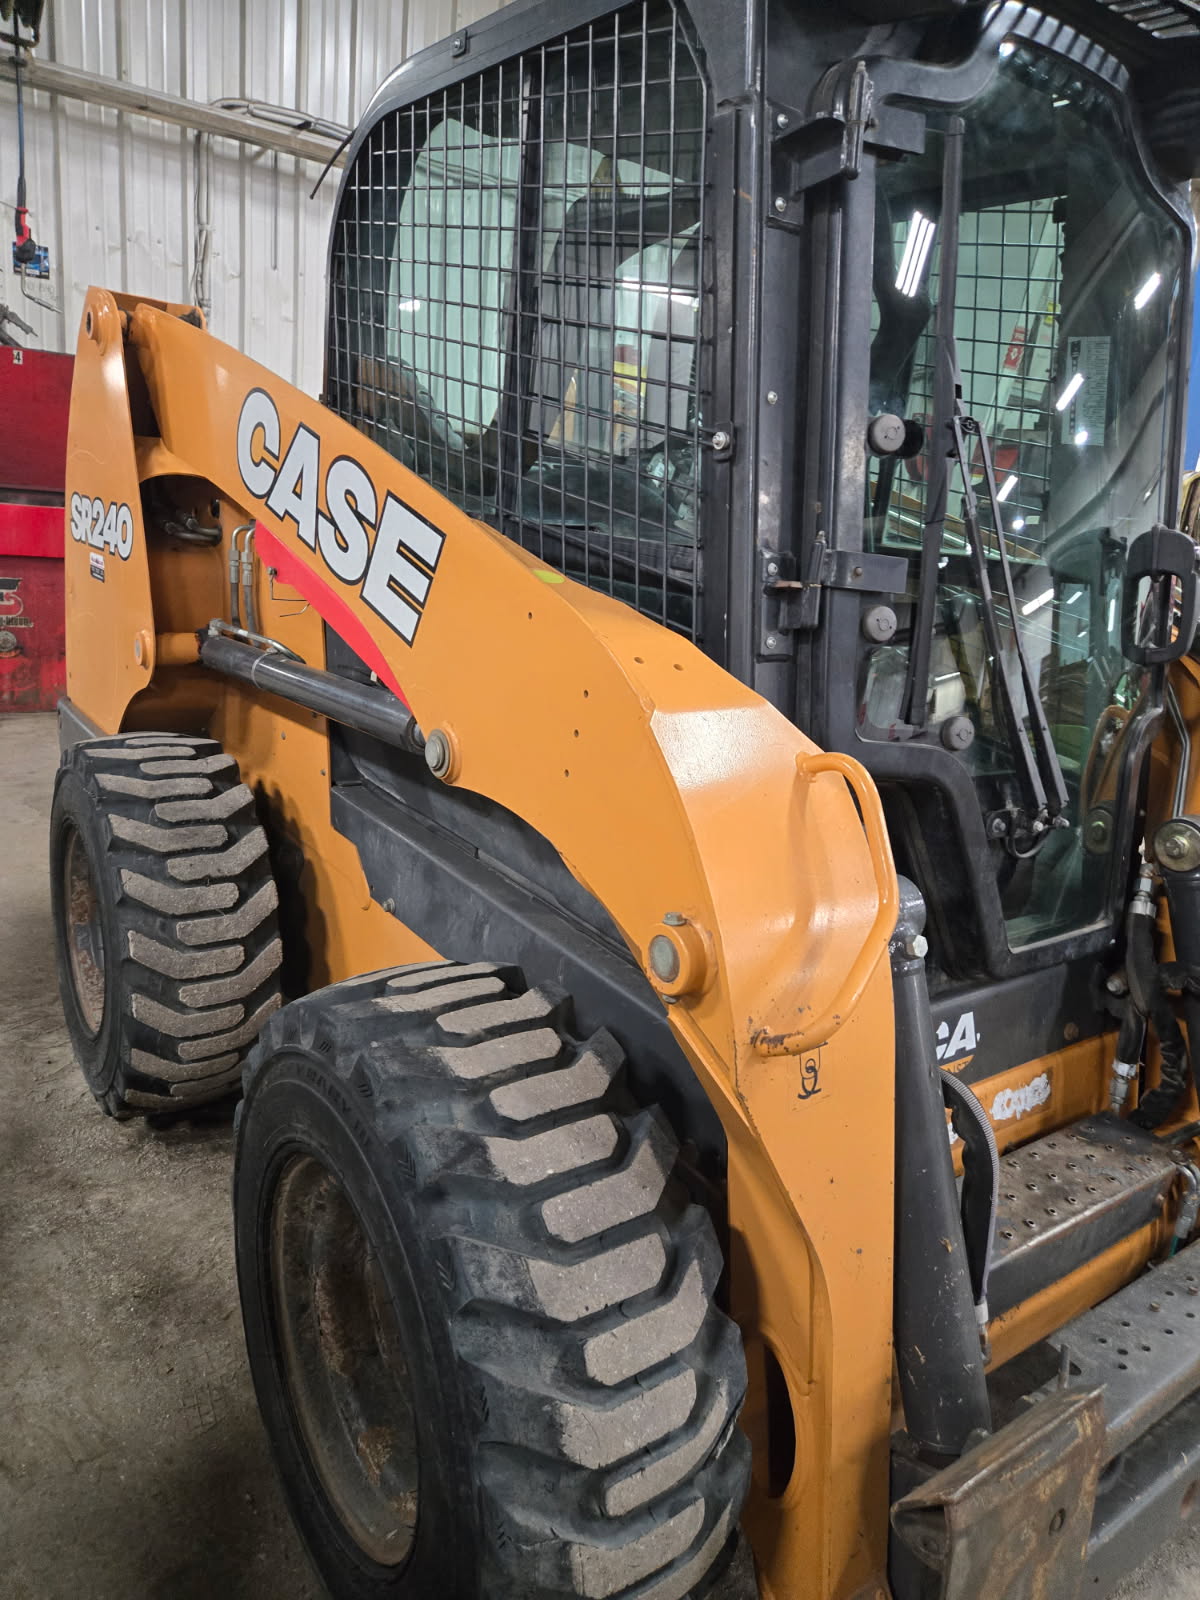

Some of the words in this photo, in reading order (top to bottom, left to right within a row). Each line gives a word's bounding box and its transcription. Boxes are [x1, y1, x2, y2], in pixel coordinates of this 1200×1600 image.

[71, 491, 133, 561] SR240
[237, 386, 447, 648] CASE
[935, 1011, 981, 1060] CA
